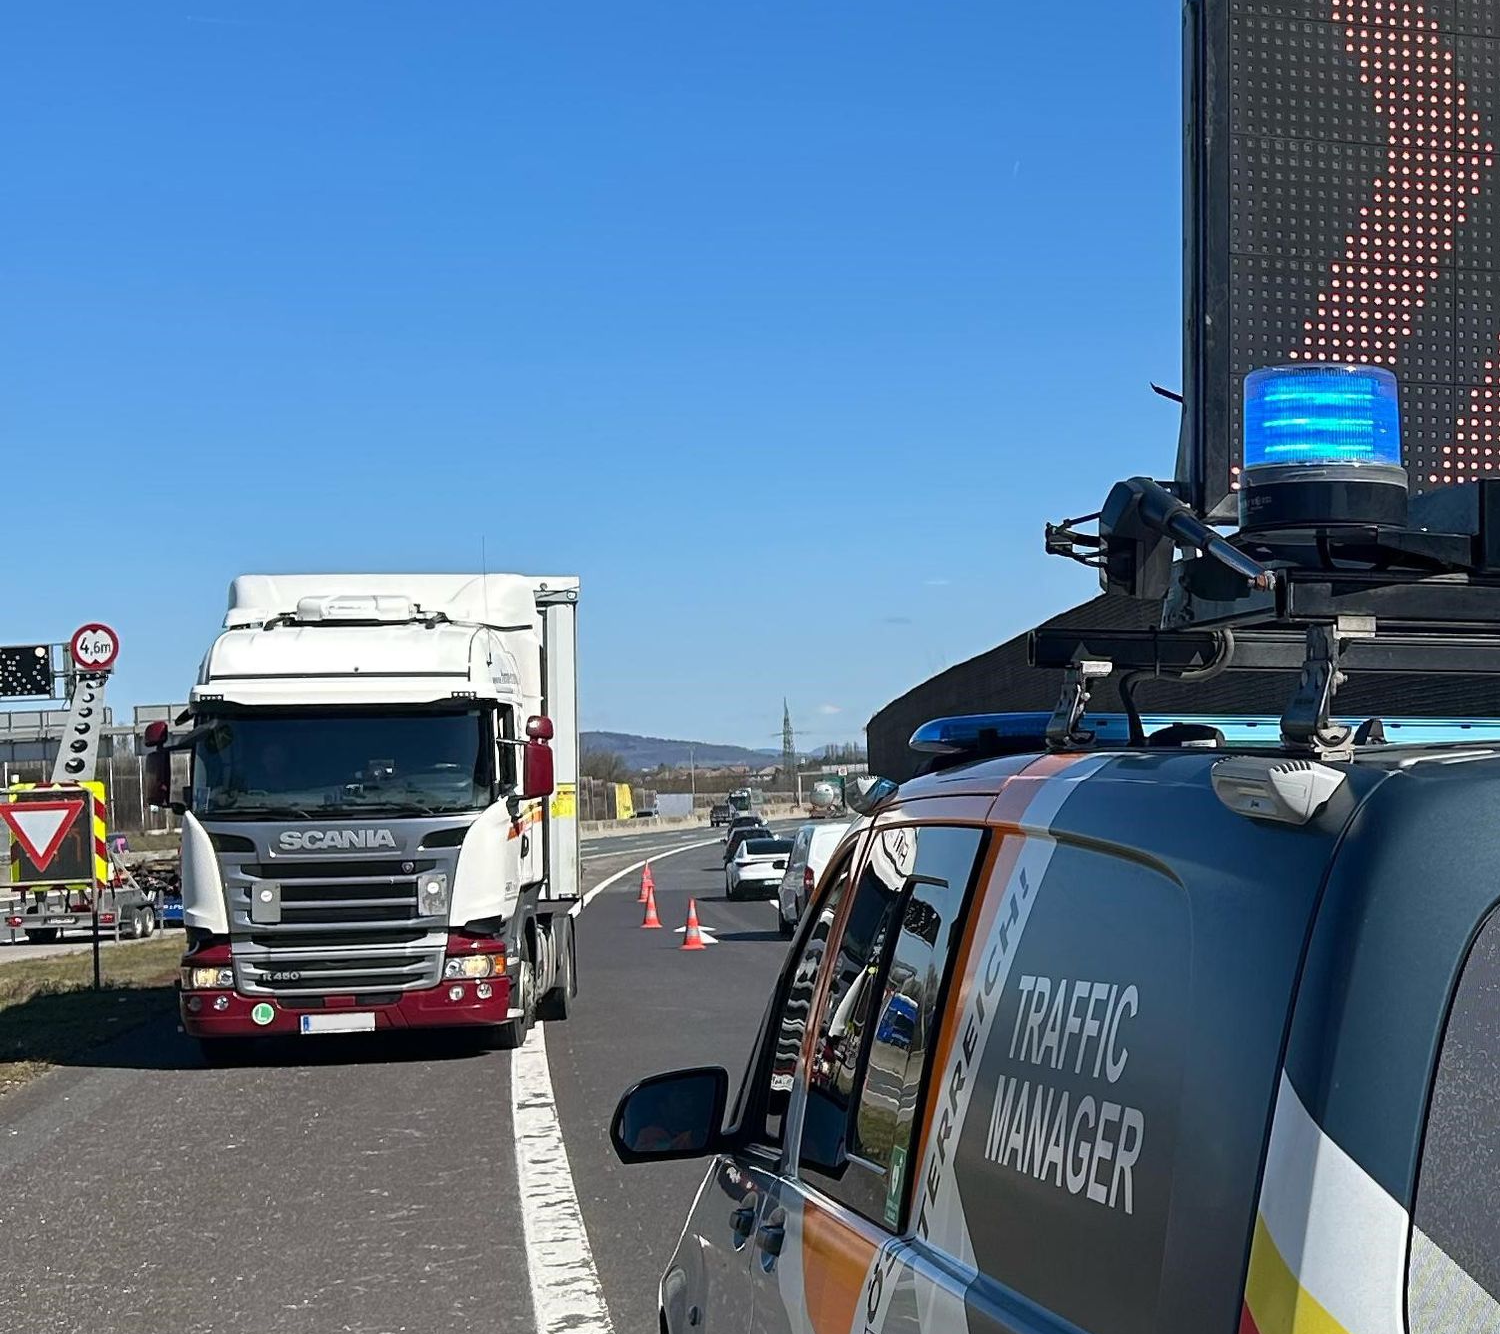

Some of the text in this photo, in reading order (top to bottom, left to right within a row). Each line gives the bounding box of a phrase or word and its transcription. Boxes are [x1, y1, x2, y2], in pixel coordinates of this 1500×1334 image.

[80, 637, 111, 656] 4,6m
[279, 829, 396, 850] SCANIA
[1009, 975, 1138, 1084] TRAFFIC
[984, 1074, 1145, 1214] MANAGER
